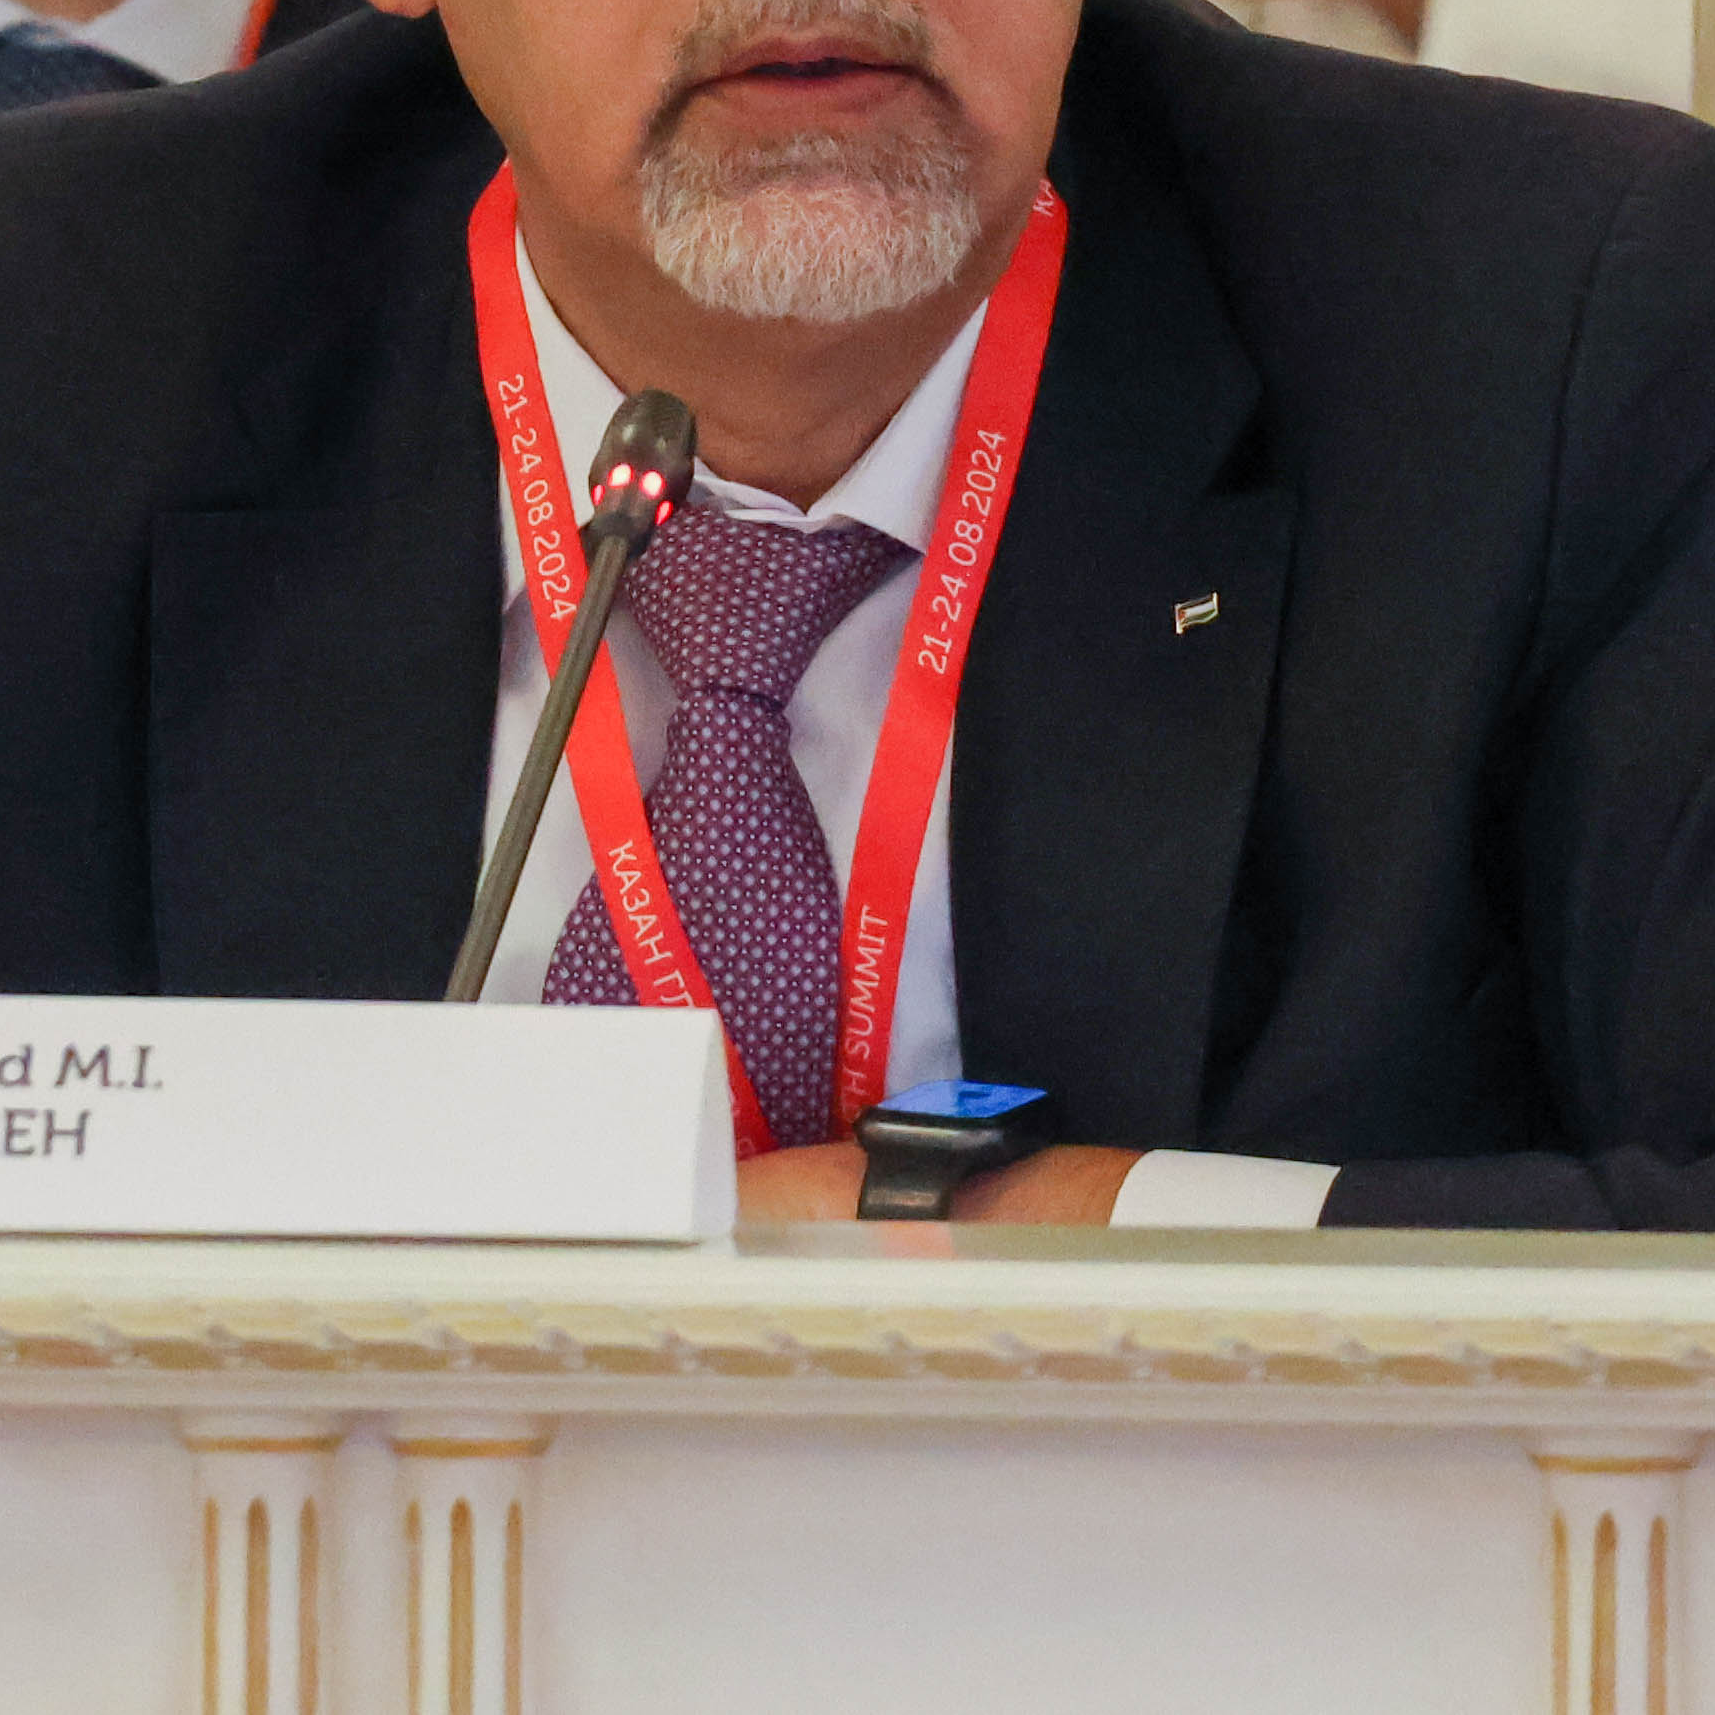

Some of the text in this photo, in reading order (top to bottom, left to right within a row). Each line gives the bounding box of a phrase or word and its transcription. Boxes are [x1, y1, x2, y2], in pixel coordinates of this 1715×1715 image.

[497, 374, 578, 620] 21-24.08.2024
[918, 429, 1006, 675] 21-24.08.2024
[608, 839, 674, 965] КАЗАН
[844, 904, 889, 1060] SUMMIT
[54, 1042, 165, 1089] M.I.
